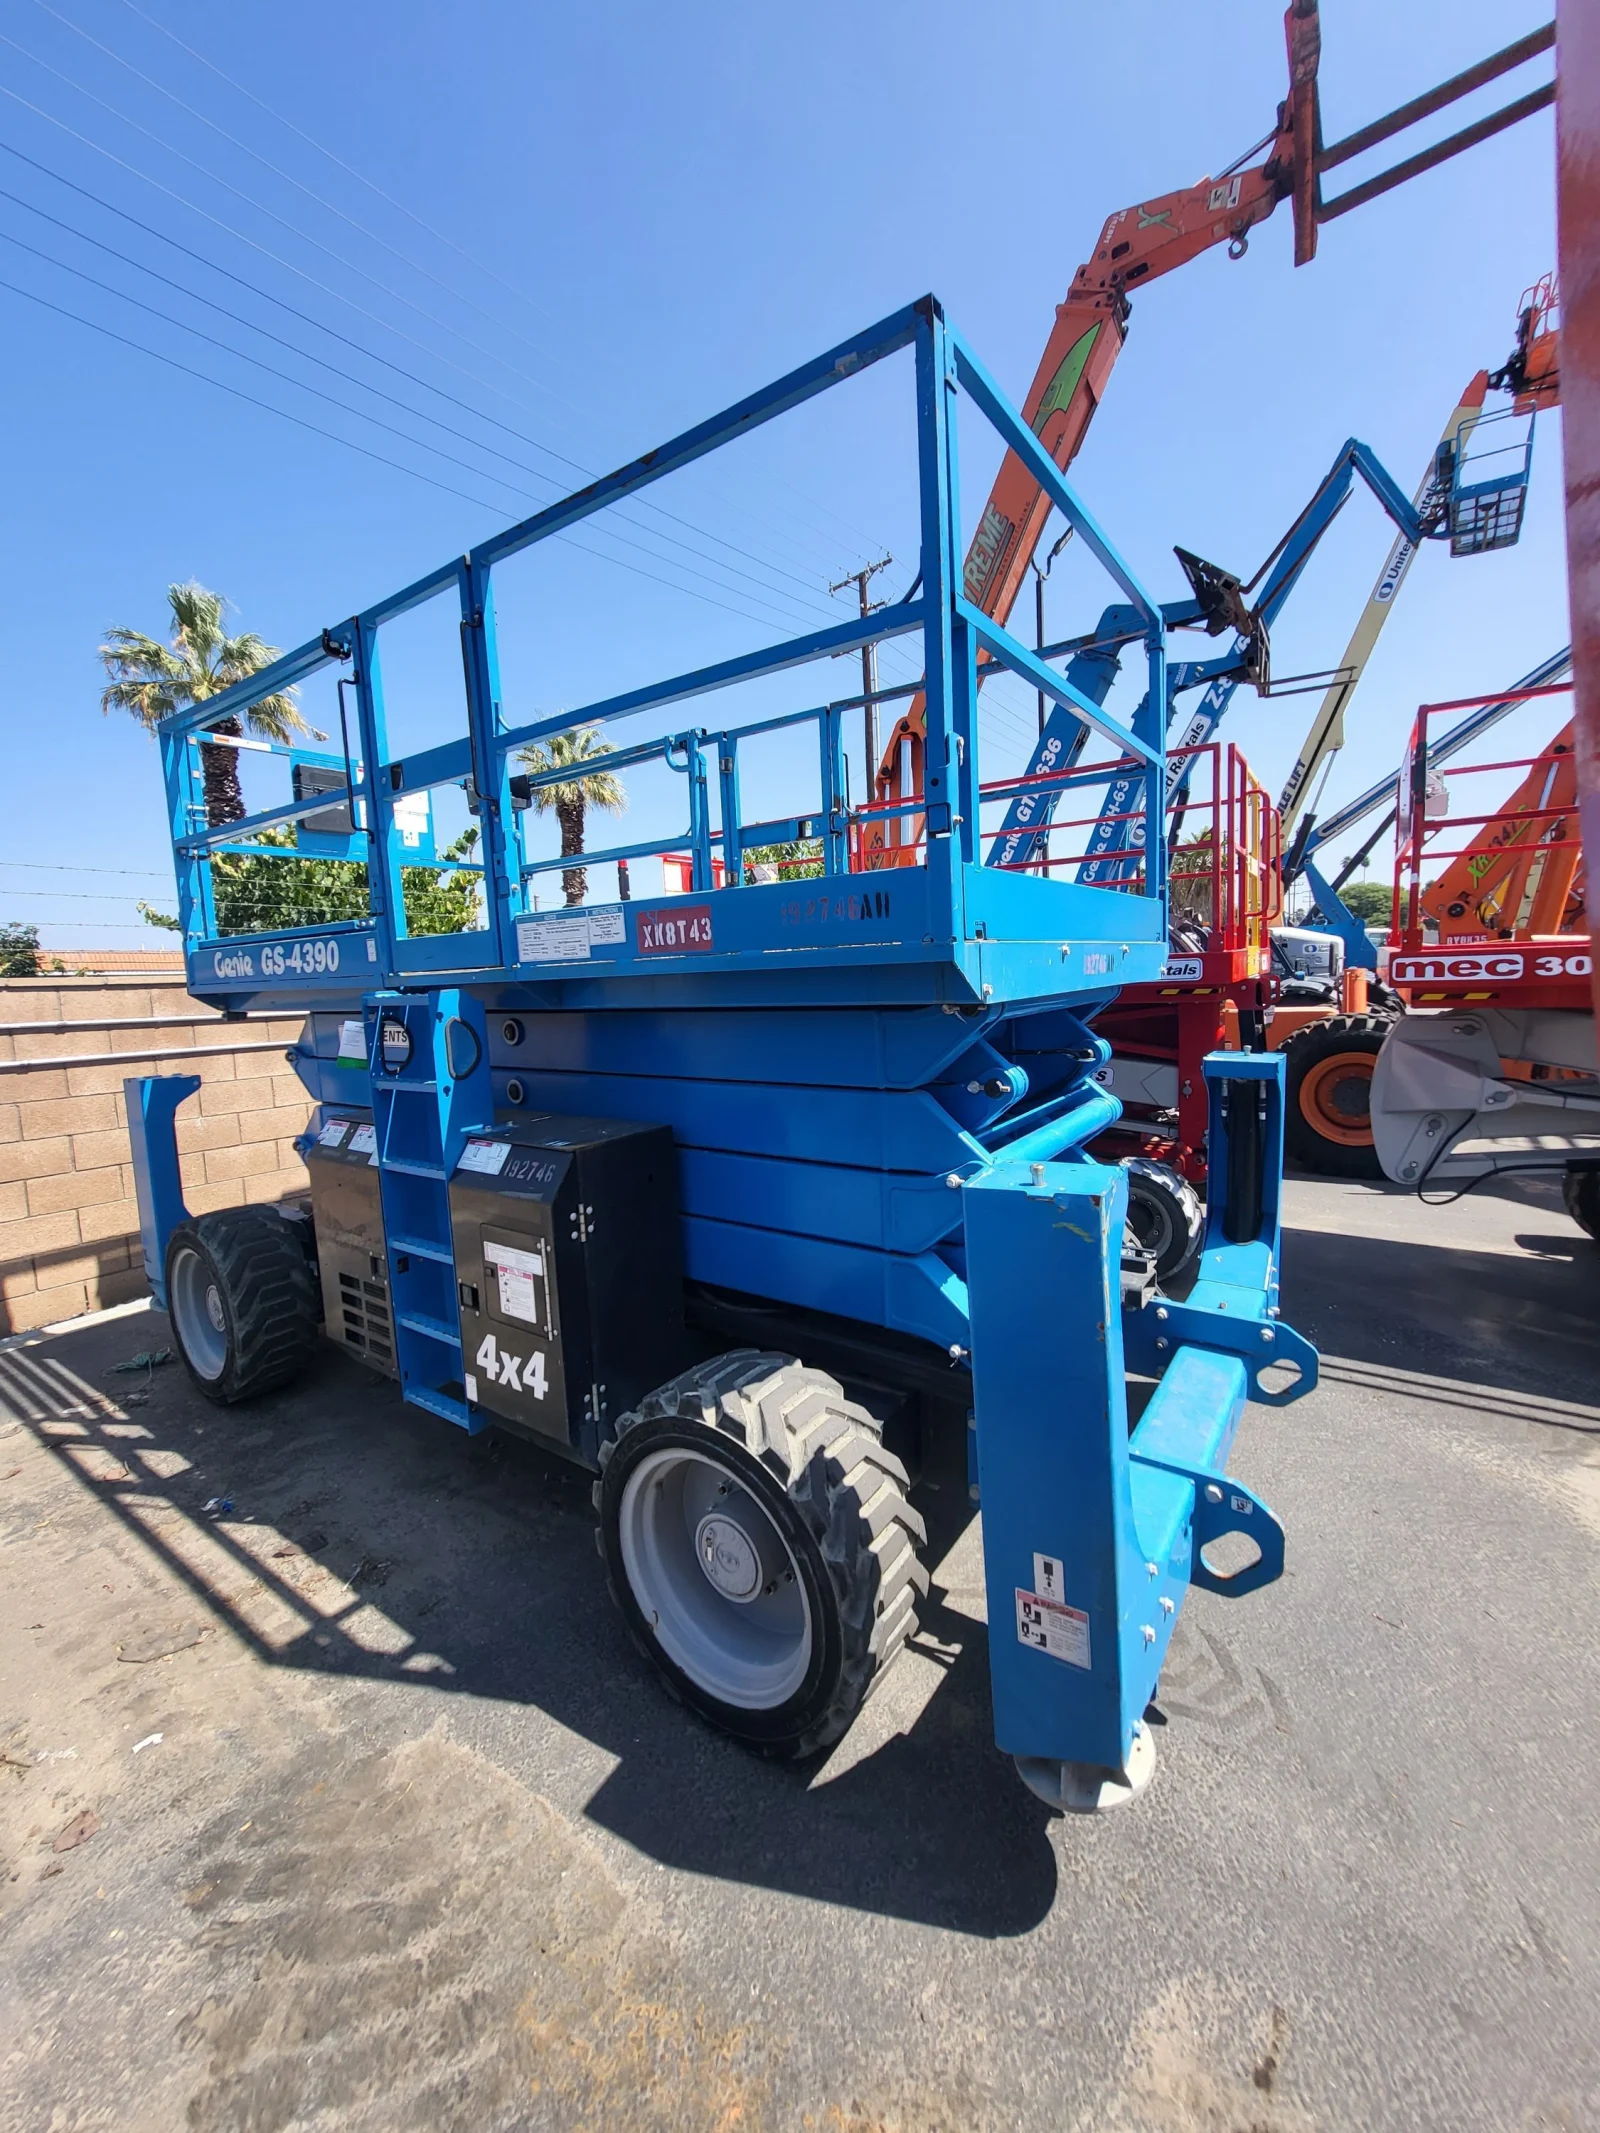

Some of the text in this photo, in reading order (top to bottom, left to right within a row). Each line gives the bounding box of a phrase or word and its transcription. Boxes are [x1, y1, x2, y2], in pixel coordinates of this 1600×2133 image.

[1387, 541, 1411, 579] Unite
[1276, 758, 1306, 817] JLG LIFT
[1082, 841, 1108, 882] Geie
[642, 917, 713, 948] XK8T43
[213, 939, 340, 979] Genie GS-4390
[1166, 964, 1198, 976] tals
[1395, 955, 1594, 979] mec 30
[383, 1030, 408, 1043] ENTS
[503, 1159, 556, 1182] 192746
[476, 1333, 549, 1401] 4x4
